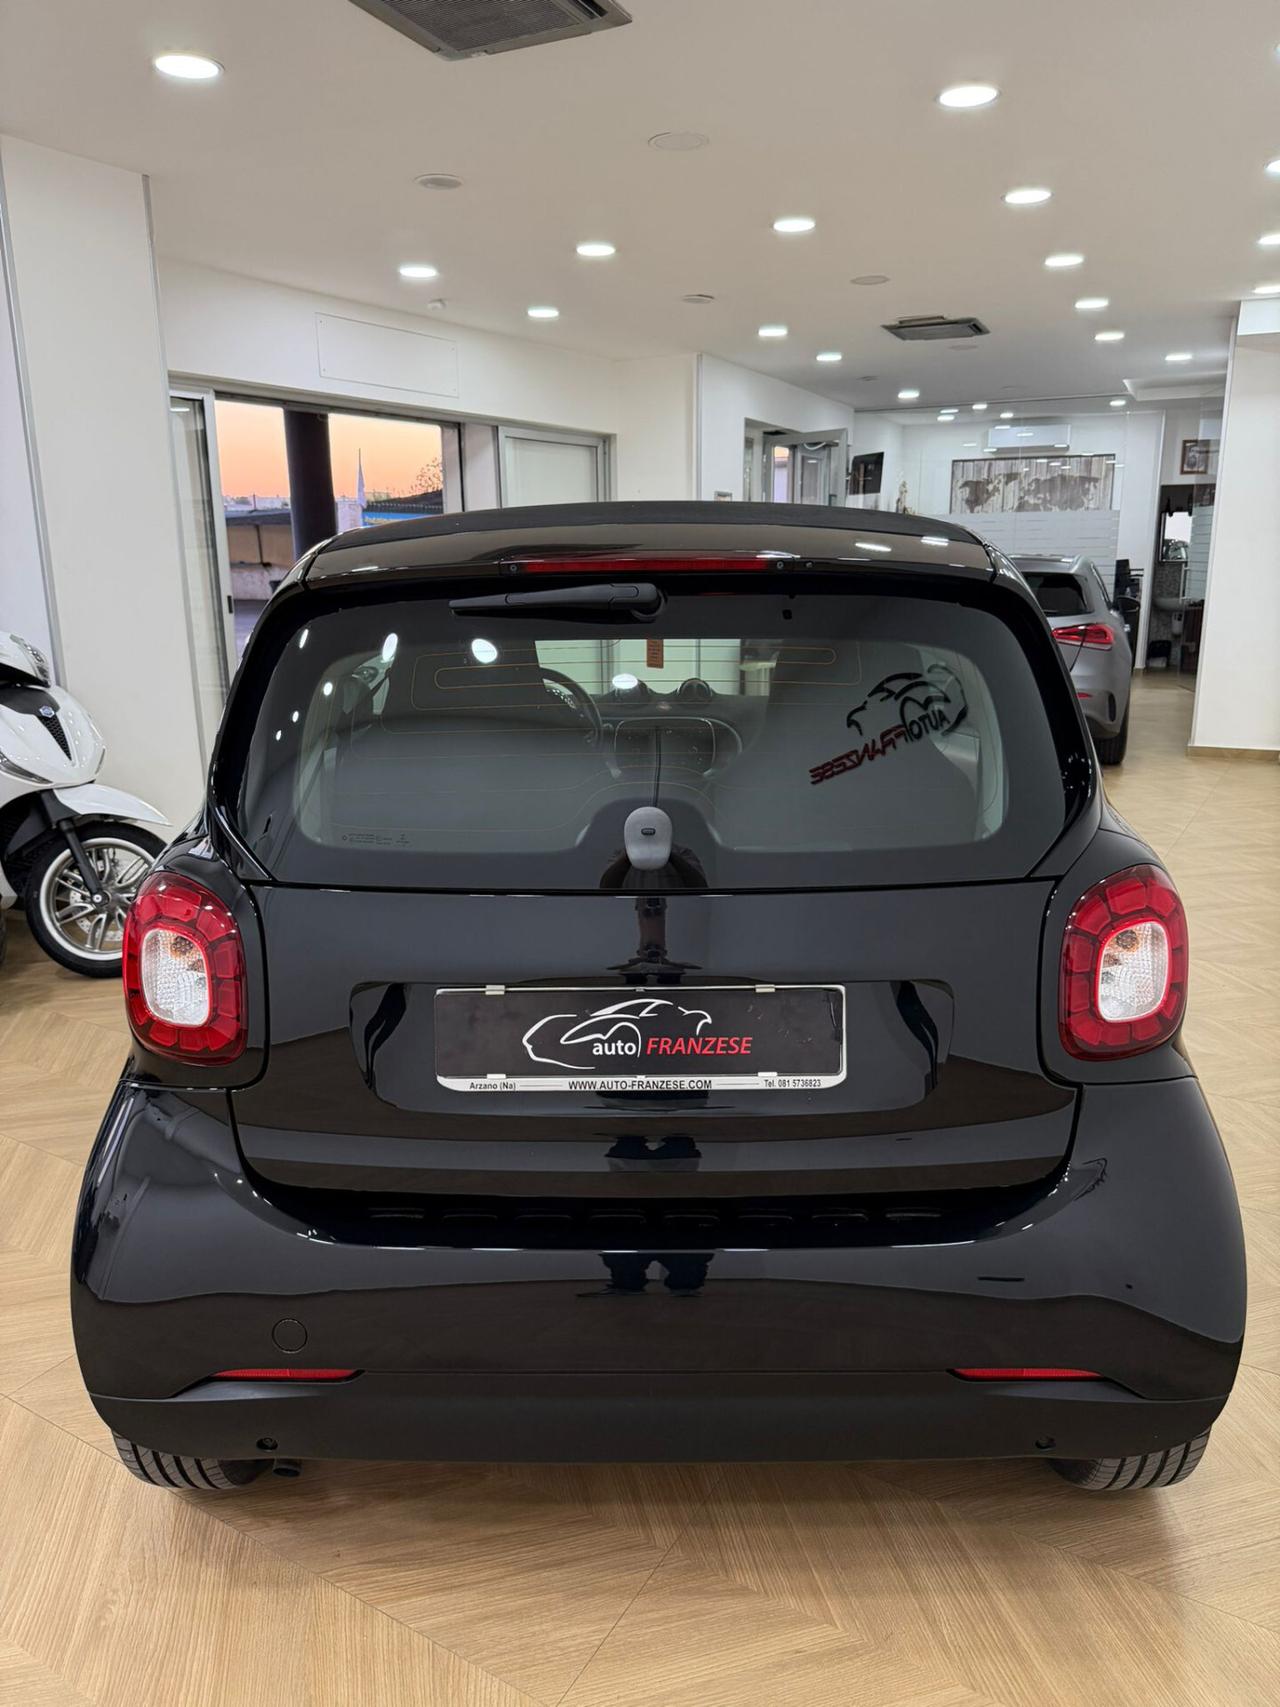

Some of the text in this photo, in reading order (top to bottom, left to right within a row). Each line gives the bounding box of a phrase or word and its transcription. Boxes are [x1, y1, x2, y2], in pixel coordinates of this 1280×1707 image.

[592, 1036, 753, 1056] auto FRANZESE
[469, 1081, 516, 1092] Arzano (Na)
[568, 1079, 712, 1091] WWW.AUTO-FRANZESE.COM
[764, 1079, 821, 1088] Tel. 081 5736823
